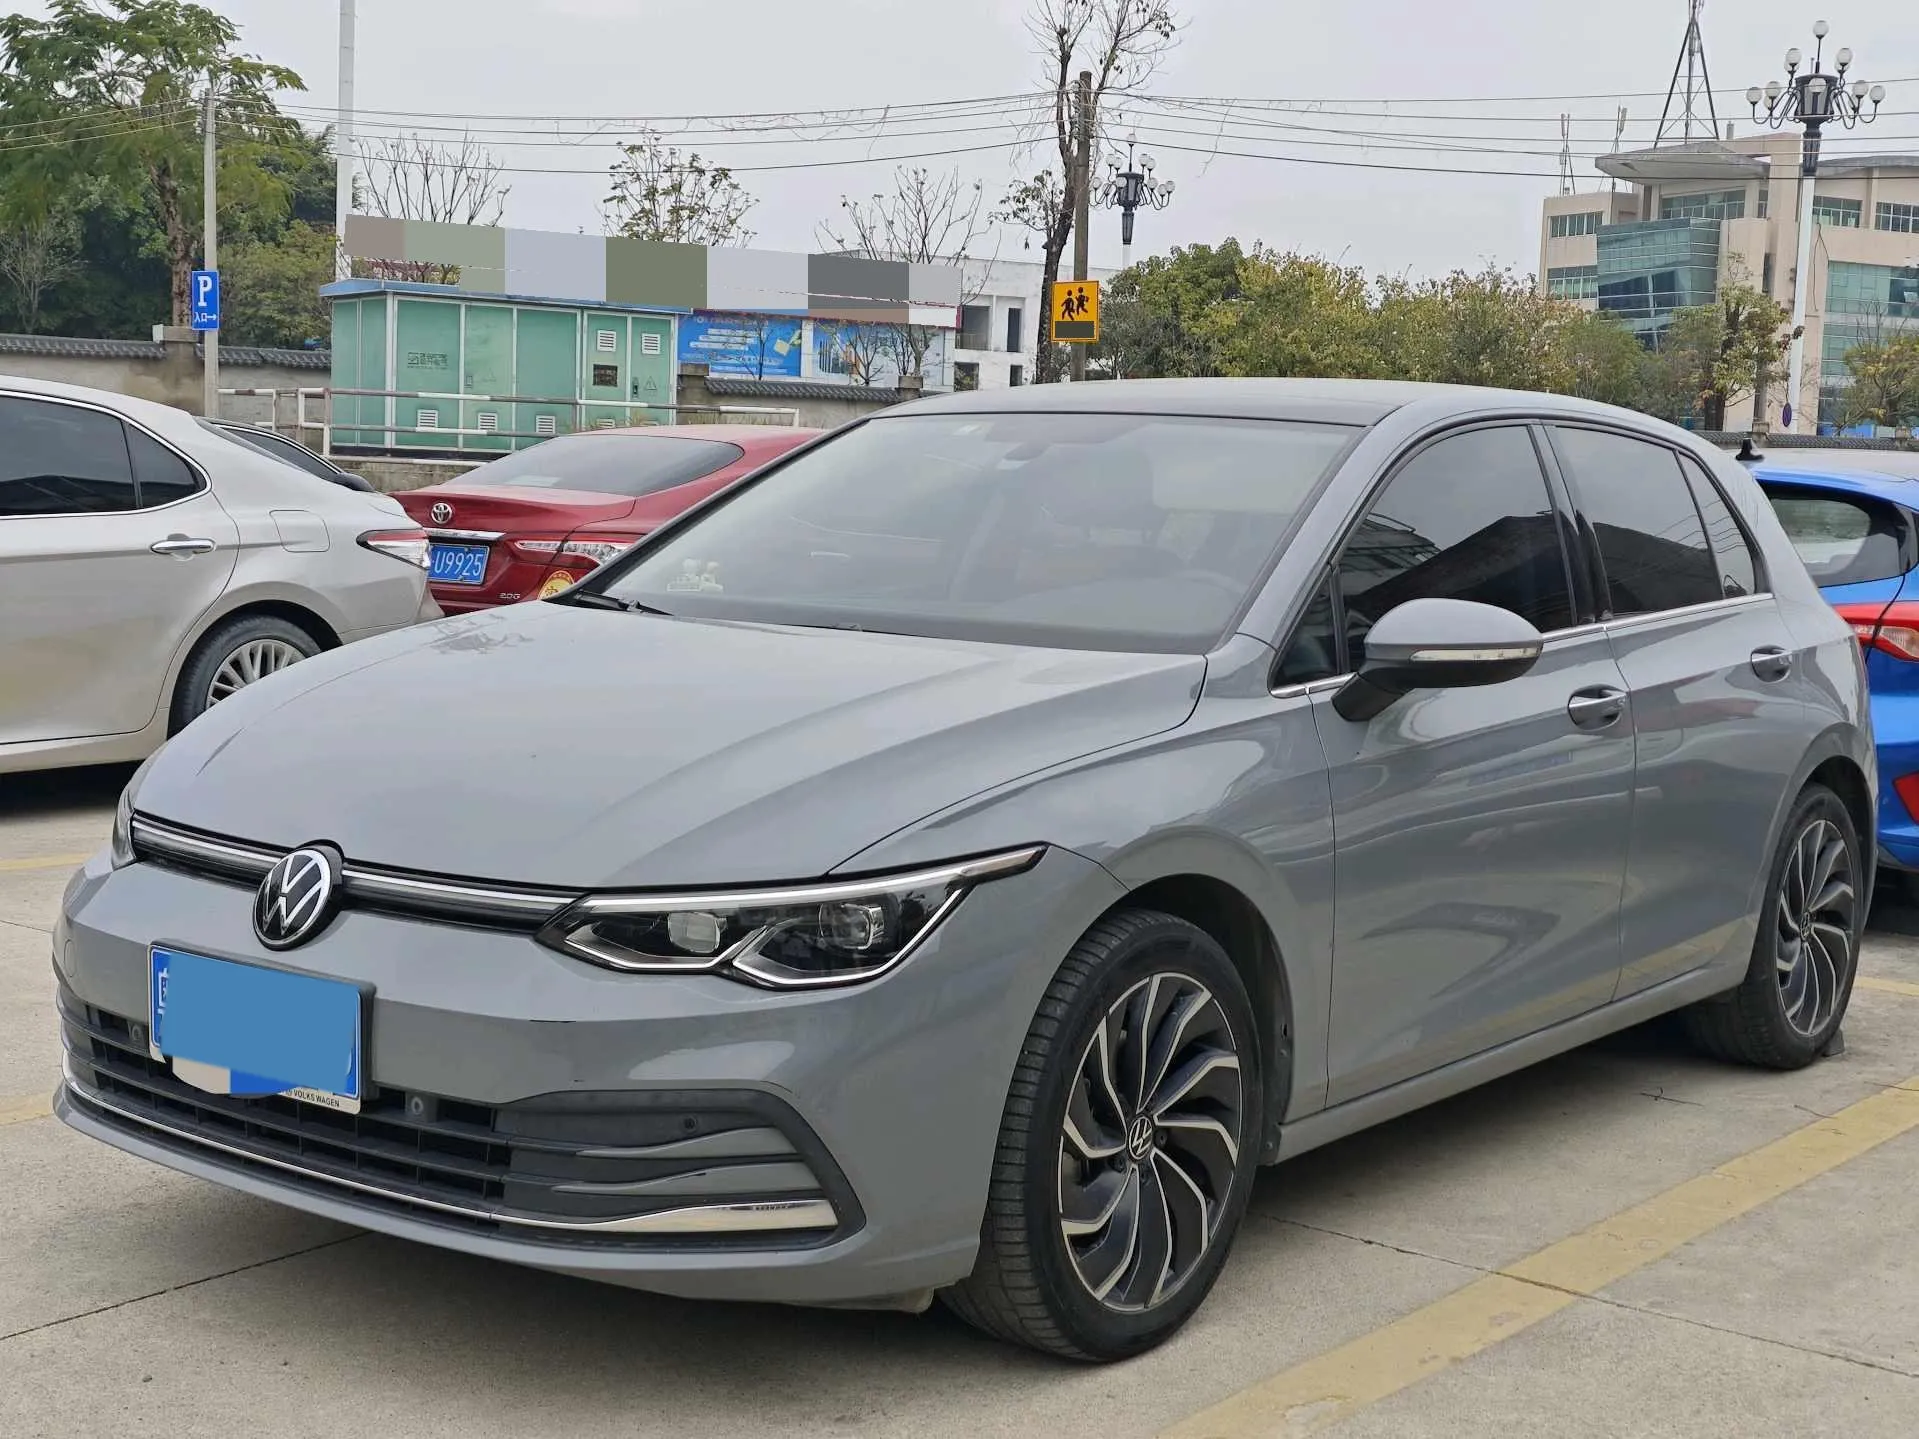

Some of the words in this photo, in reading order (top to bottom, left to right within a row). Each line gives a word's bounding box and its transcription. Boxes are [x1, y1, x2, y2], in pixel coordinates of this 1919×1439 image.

[197, 275, 213, 307] P
[194, 311, 208, 323] 入口
[434, 551, 484, 576] U9925
